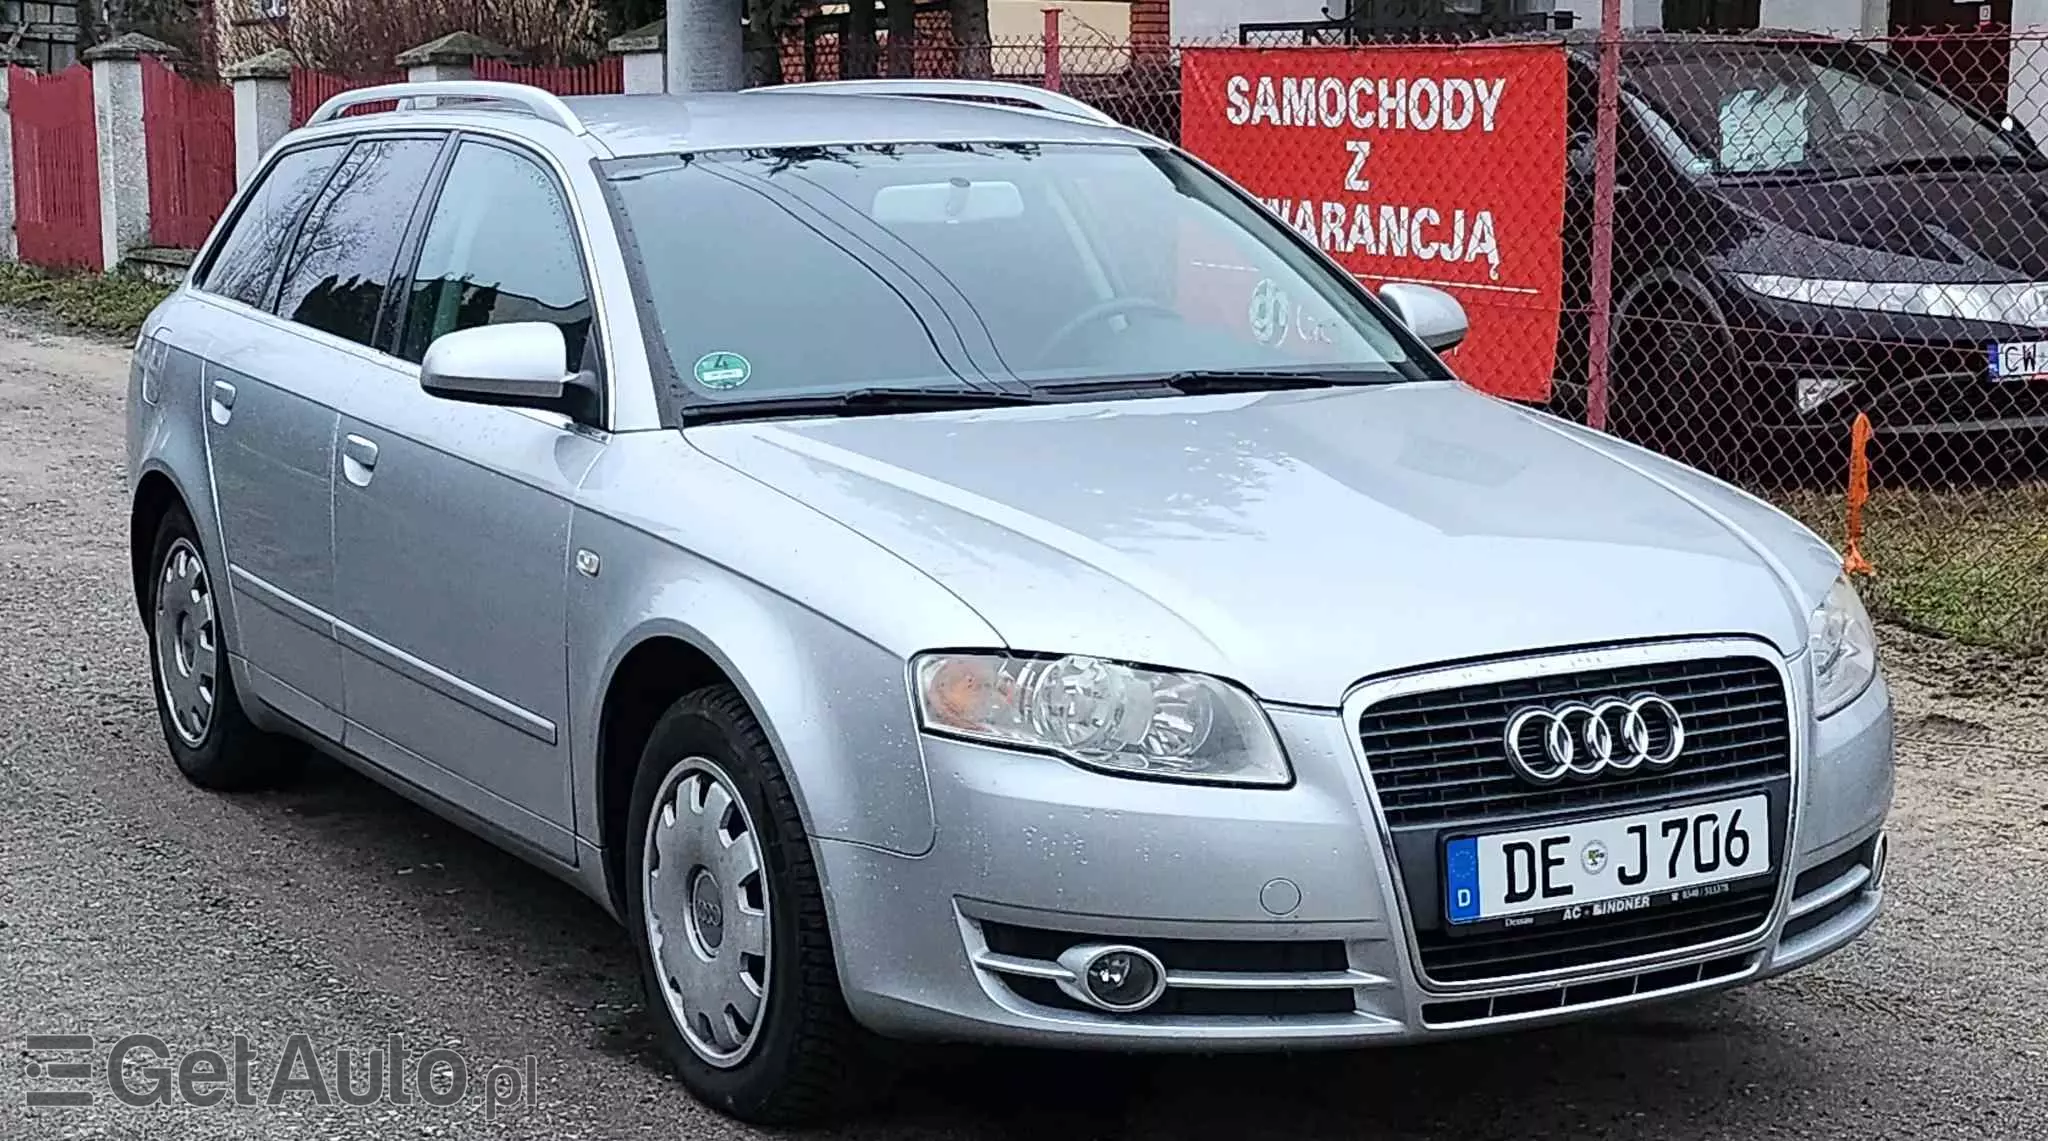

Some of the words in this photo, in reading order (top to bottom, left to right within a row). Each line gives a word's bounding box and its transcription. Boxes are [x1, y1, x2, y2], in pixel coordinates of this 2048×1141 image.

[1226, 76, 1506, 131] SAMOCHODY
[1345, 141, 1371, 192] Z
[1257, 197, 1500, 280] ARANCJĄ
[1502, 835, 1574, 905] DE
[1457, 889, 1471, 908] D
[1562, 906, 1582, 921] AC
